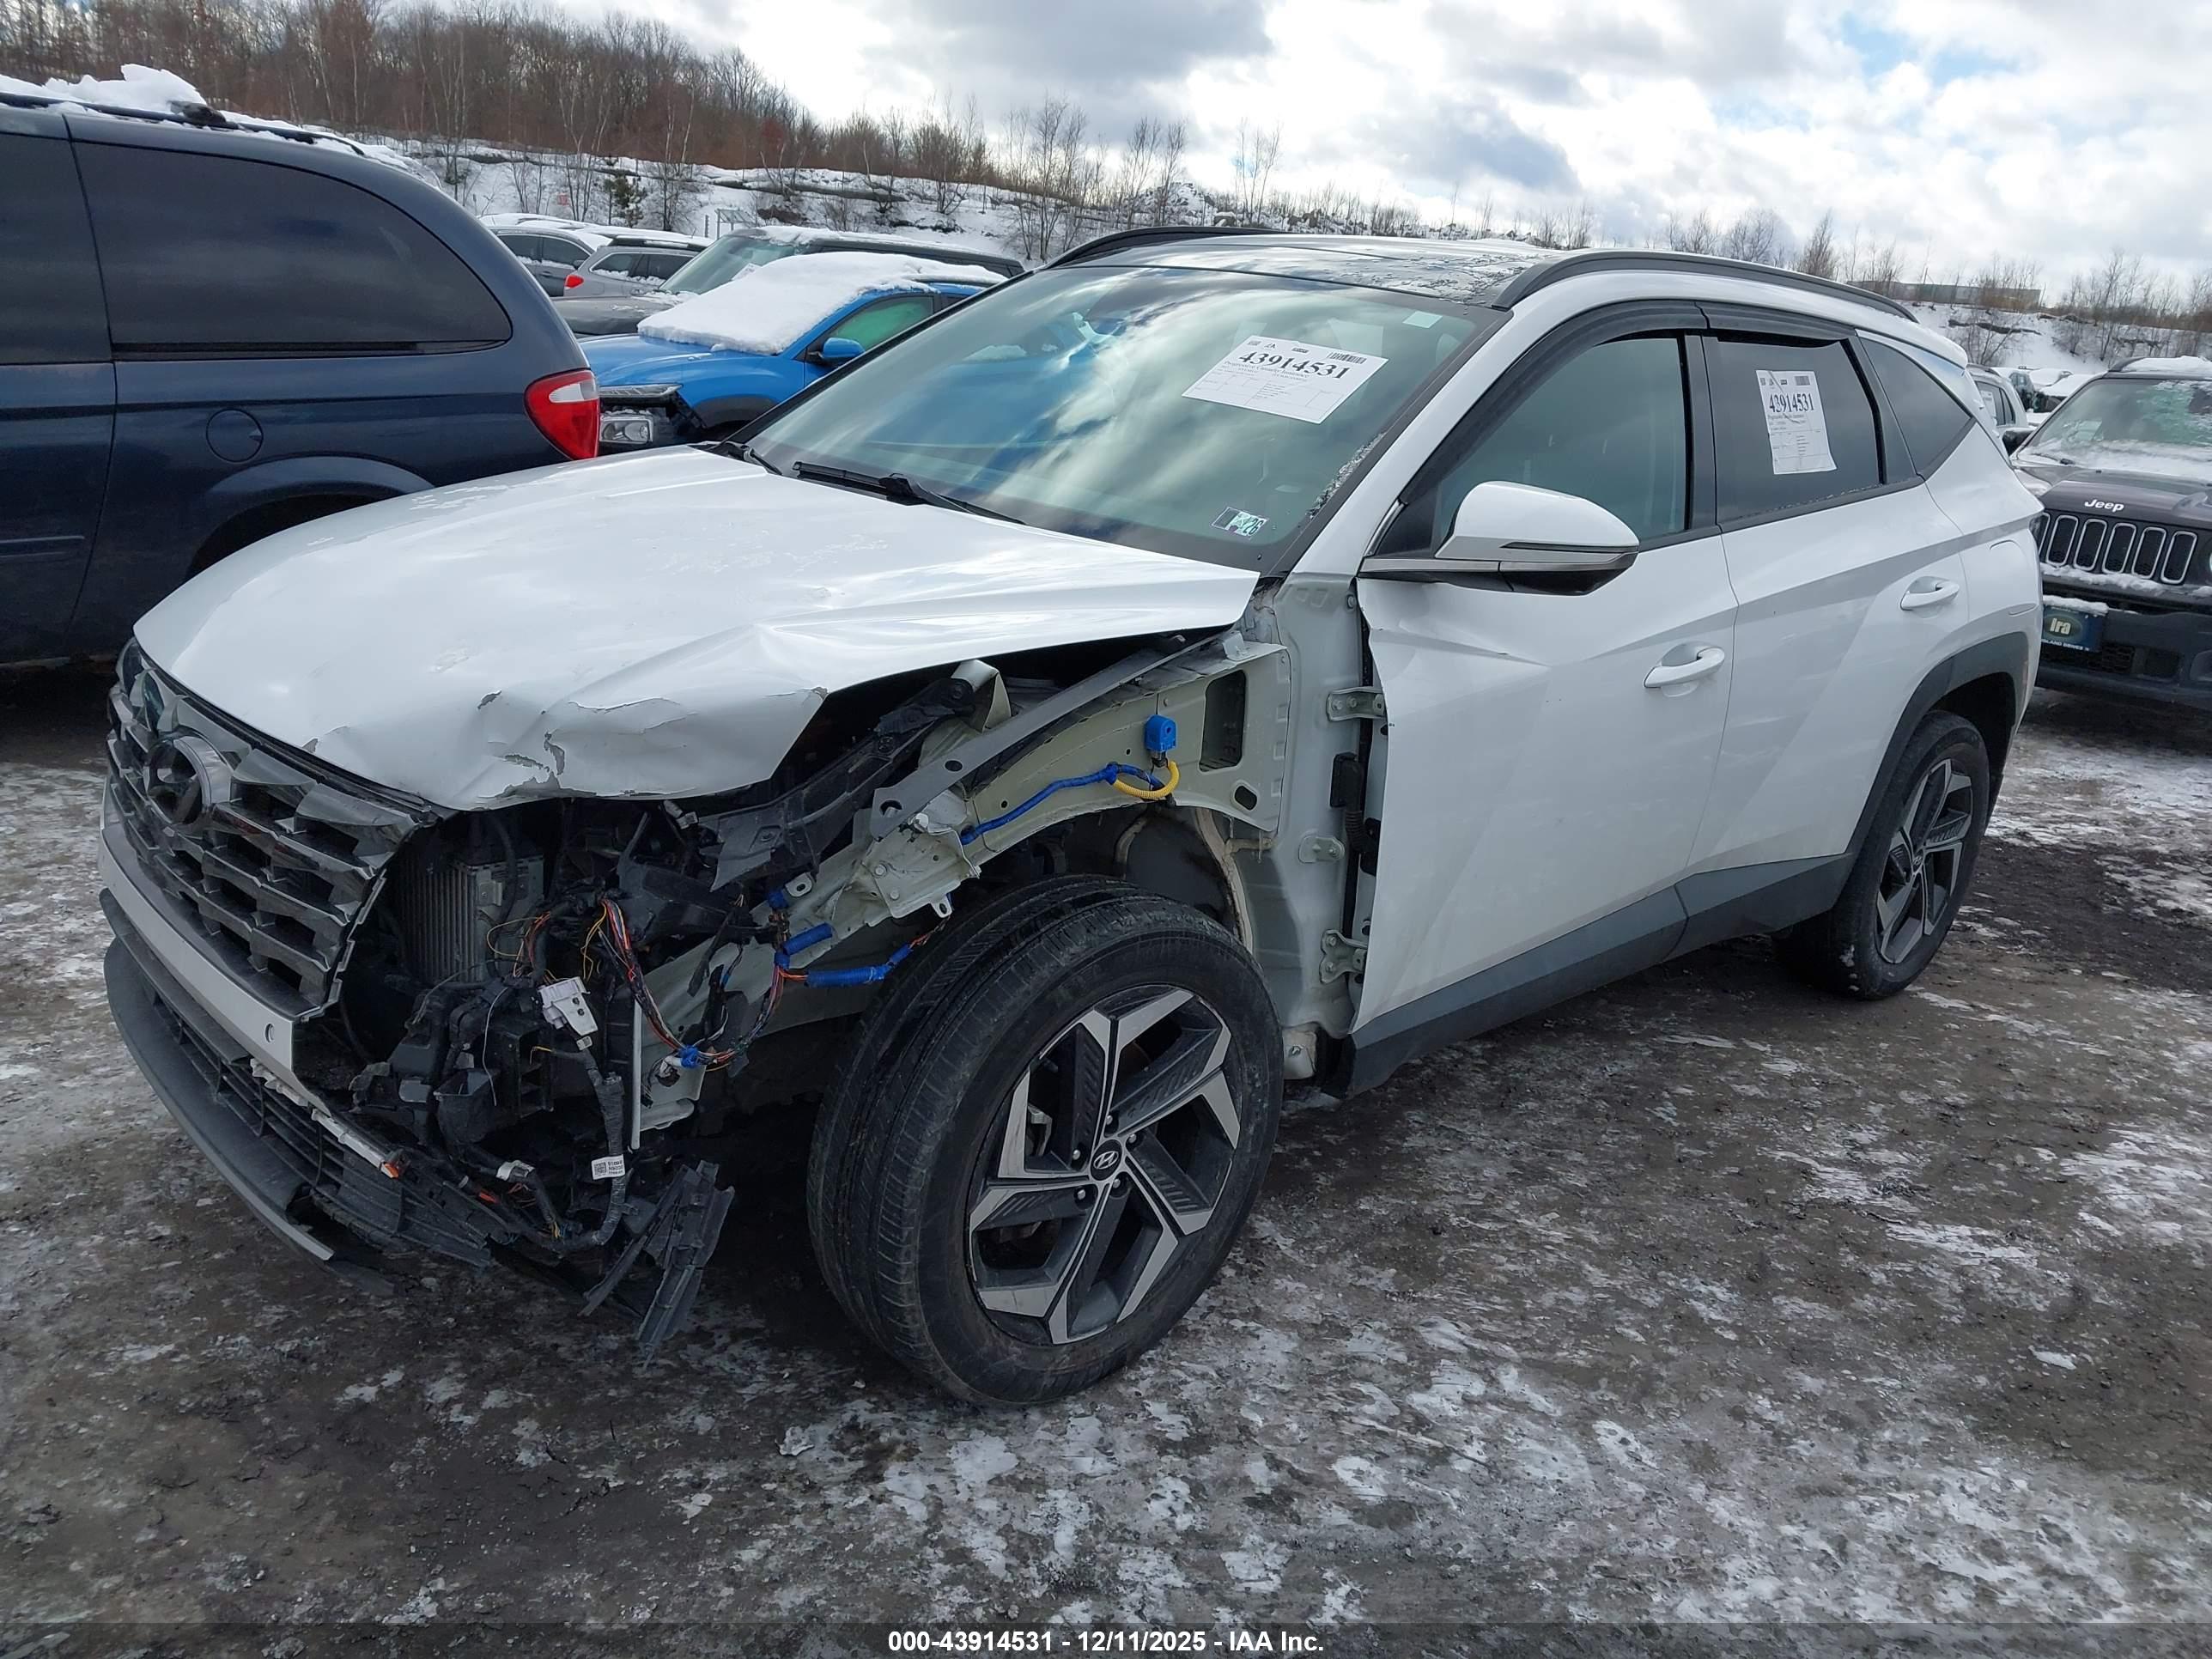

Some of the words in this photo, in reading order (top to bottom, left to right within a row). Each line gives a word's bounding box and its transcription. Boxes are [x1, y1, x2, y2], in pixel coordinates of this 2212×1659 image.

[1239, 351, 1350, 379] 43914531
[1769, 393, 1814, 412] 43914531
[2084, 499, 2124, 513] Jeep
[2050, 617, 2071, 635] Ira
